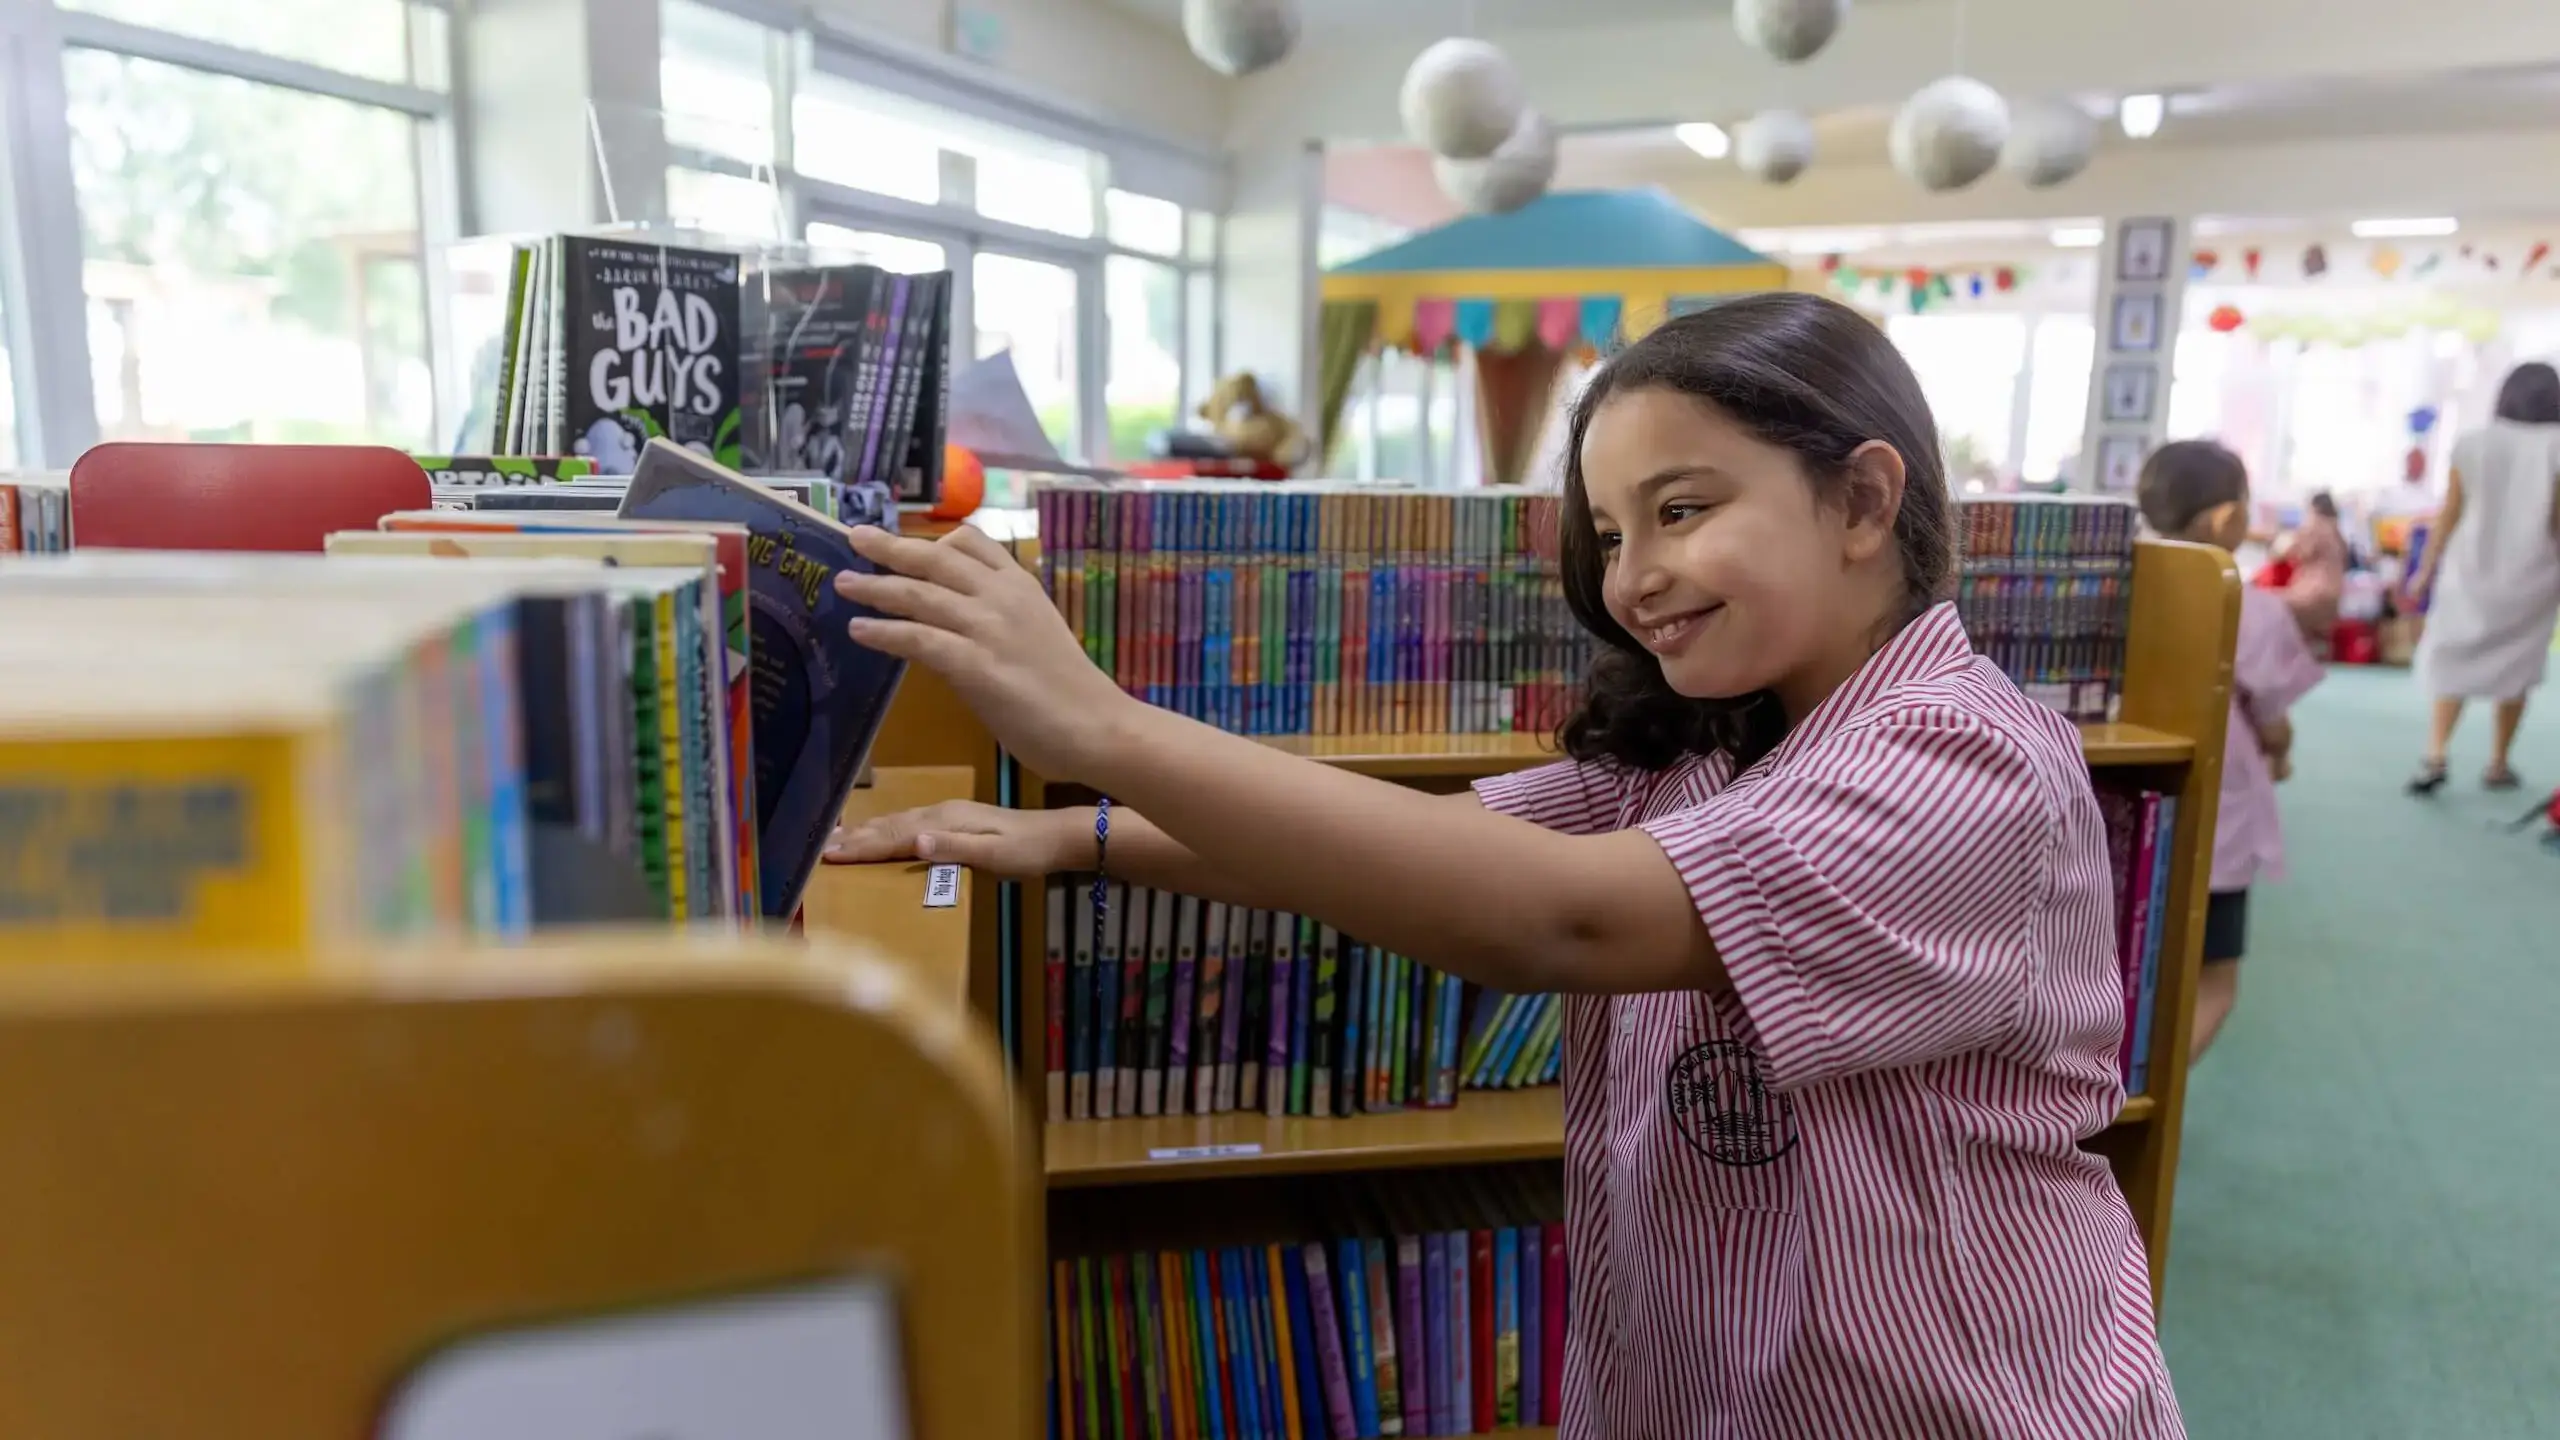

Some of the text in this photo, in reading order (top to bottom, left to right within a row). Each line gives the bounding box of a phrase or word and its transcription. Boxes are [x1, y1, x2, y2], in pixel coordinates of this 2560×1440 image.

[613, 286, 718, 354] BAD
[590, 345, 722, 416] GUYS
[779, 548, 829, 606] GANG
